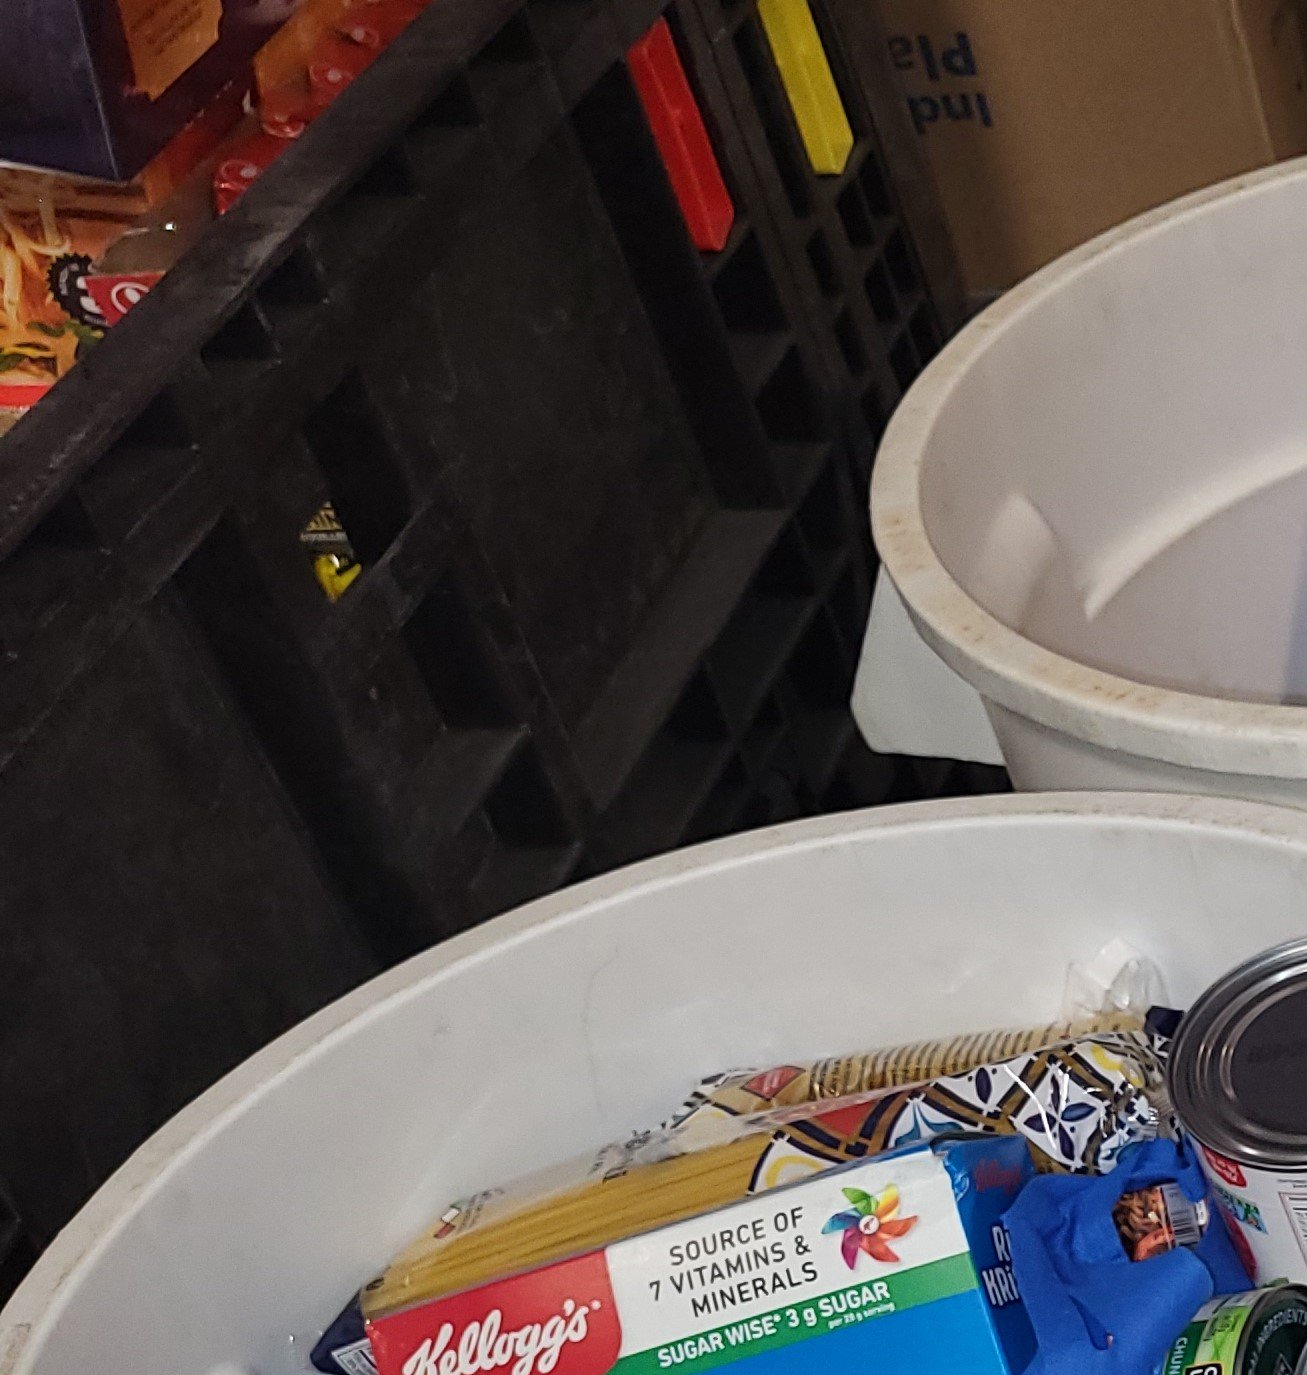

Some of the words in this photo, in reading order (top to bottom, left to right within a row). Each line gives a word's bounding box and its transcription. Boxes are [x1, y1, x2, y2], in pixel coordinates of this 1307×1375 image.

[649, 1279, 662, 1303] 7
[669, 1245, 786, 1293] VITAMINS
[793, 1235, 812, 1258] &
[668, 1223, 768, 1268] SOURCE
[773, 1206, 806, 1243] OF
[691, 1262, 819, 1318] MINERALS
[657, 1331, 725, 1369] SUGAR
[725, 1314, 781, 1347] WISE
[786, 1308, 801, 1328] 3
[803, 1307, 818, 1327] g
[817, 1280, 891, 1318] SUGAR
